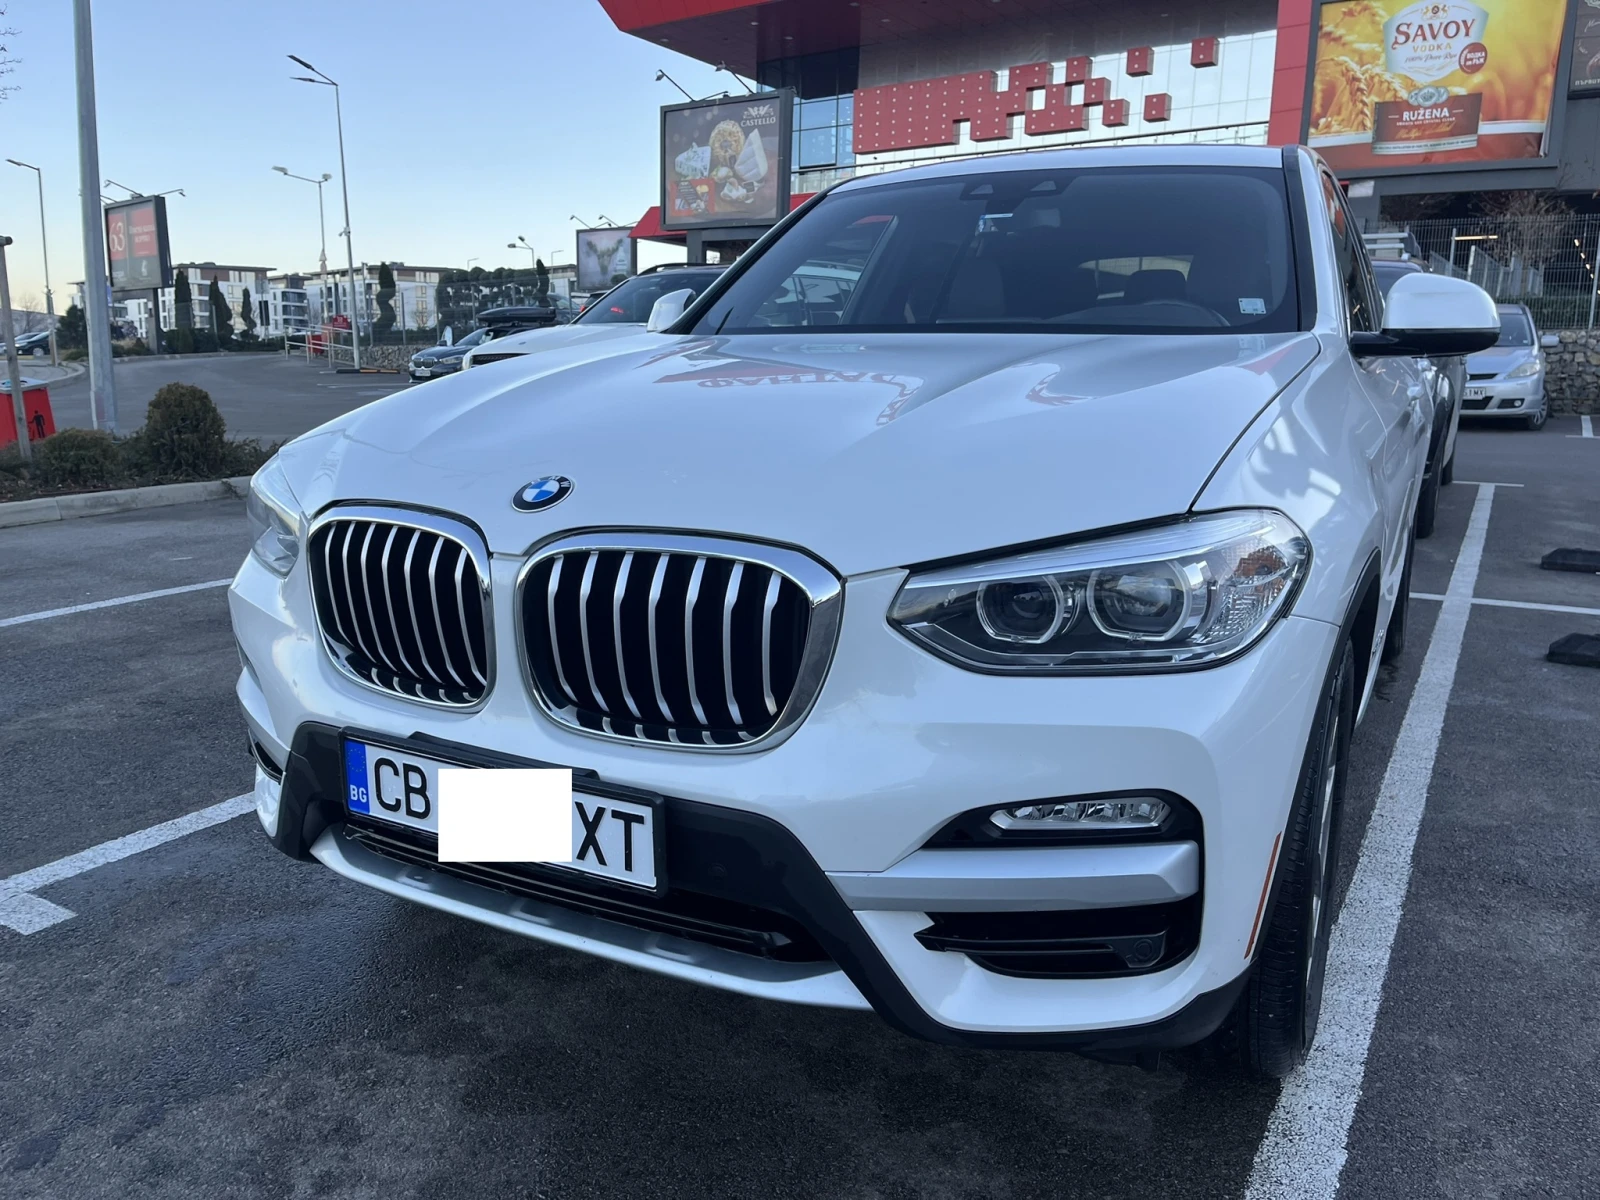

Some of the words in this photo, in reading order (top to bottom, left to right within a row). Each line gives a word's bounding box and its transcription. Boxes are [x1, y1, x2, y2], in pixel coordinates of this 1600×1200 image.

[1391, 19, 1476, 50] SAVOY
[1412, 42, 1453, 53] VODKA
[740, 116, 777, 128] CASTELLO
[1402, 107, 1450, 122] RUŽENA
[349, 784, 368, 803] BG
[373, 757, 431, 820] CB
[574, 801, 645, 872] XT
